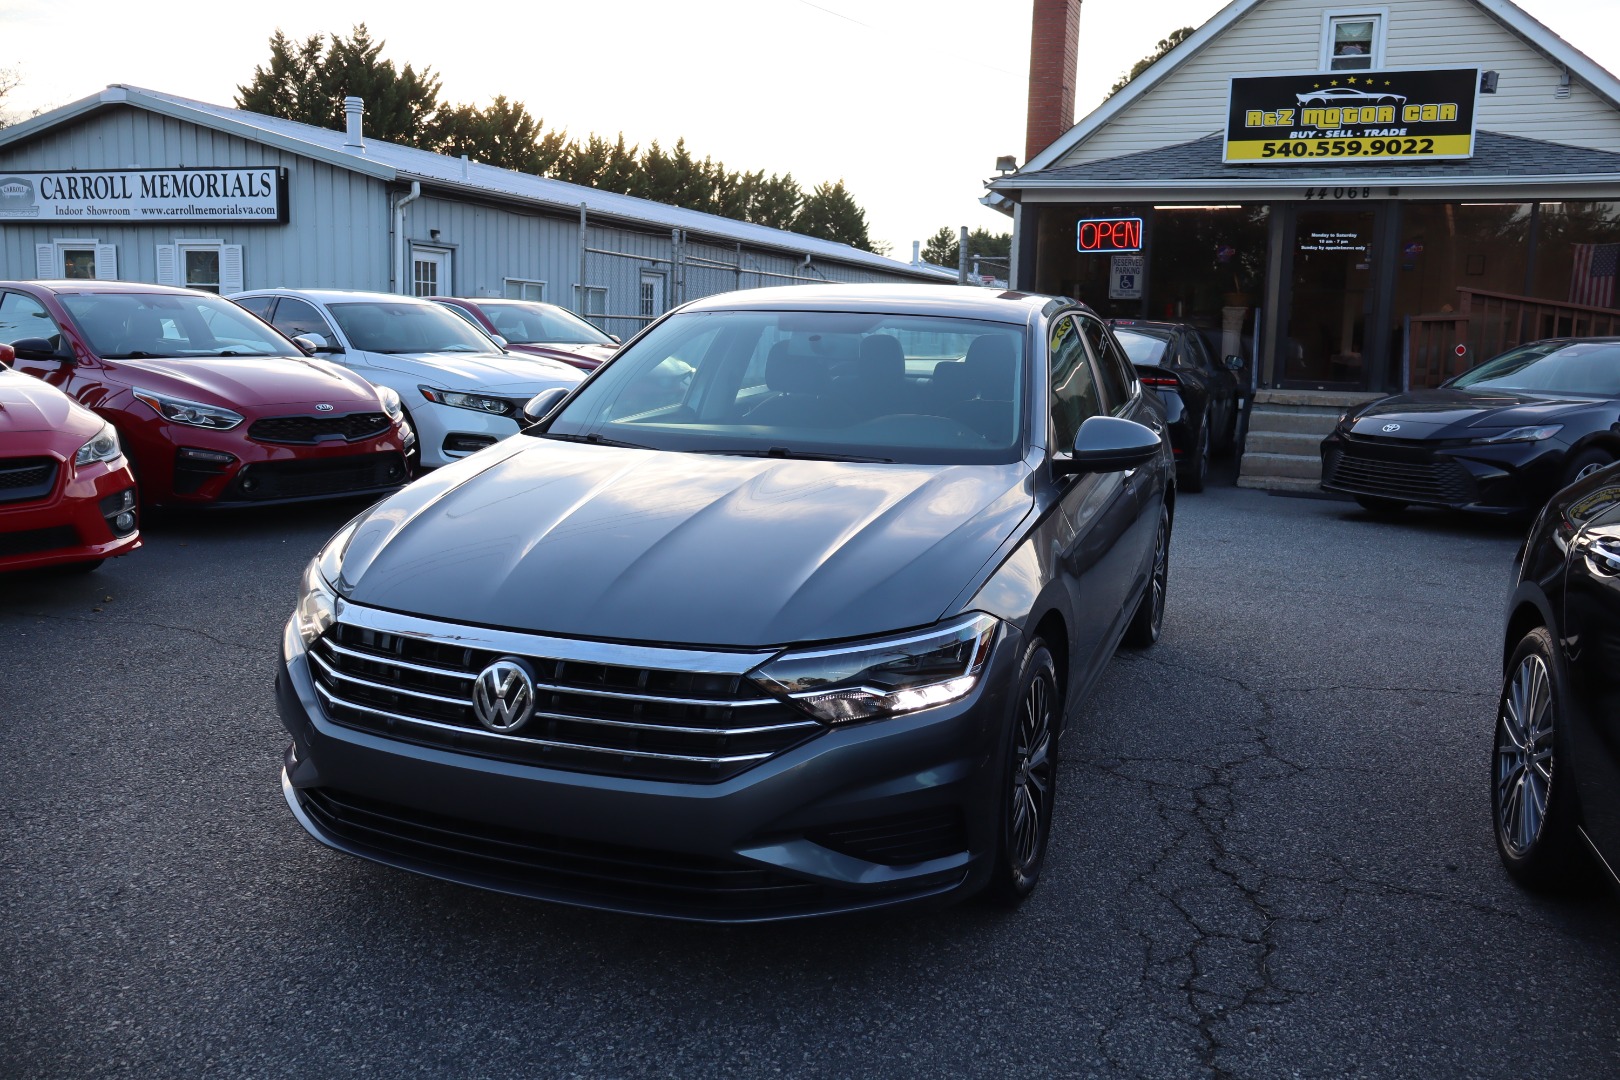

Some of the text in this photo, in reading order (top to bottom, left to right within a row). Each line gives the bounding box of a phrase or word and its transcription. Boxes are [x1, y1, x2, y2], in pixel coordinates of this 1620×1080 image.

[1289, 128, 1408, 139] BUY SELL TRADE
[1261, 138, 1434, 158] 540.559.9022
[40, 172, 272, 200] CARROLL MEMORIALS
[55, 203, 276, 216] Indoor Showroom www.carrollmemorialsva.com
[1080, 221, 1140, 249] OPEN
[1113, 258, 1144, 267] RESERVED
[1115, 266, 1141, 275] PARKING
